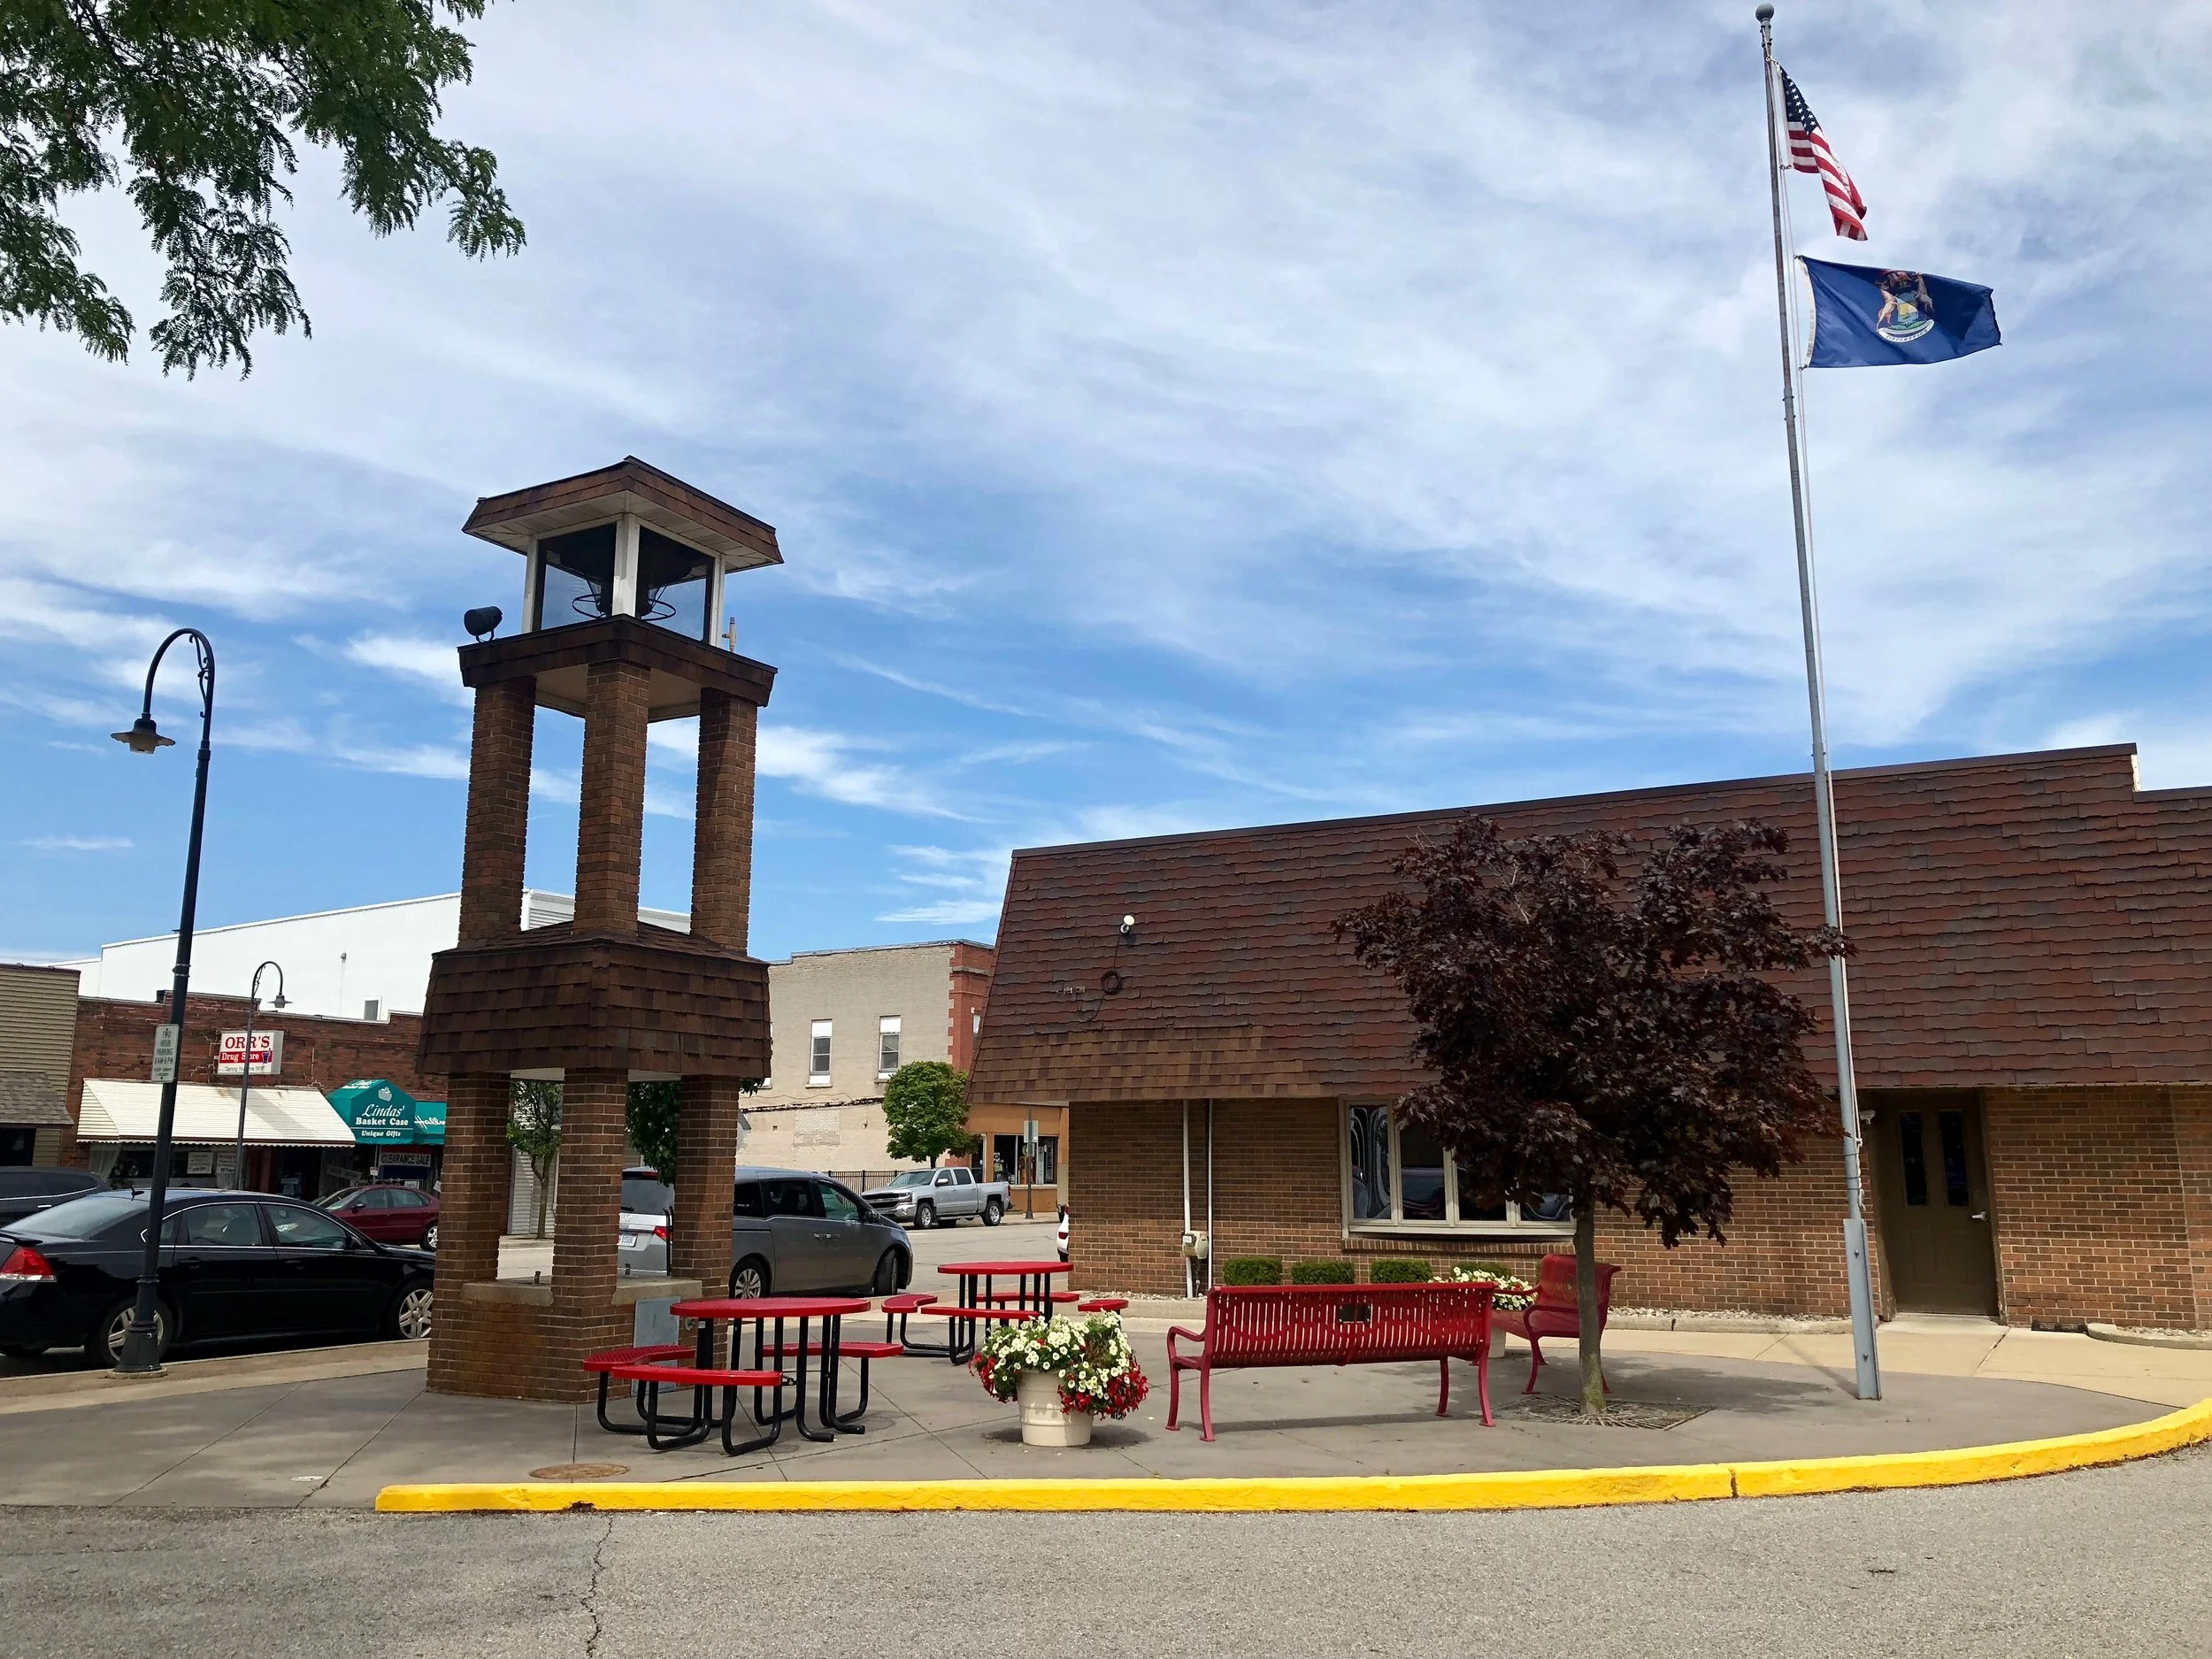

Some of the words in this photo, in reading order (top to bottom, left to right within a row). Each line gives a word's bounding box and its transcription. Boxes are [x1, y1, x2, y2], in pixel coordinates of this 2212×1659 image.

[225, 1035, 270, 1048] ORR'S
[221, 1052, 239, 1063] Drug
[362, 1103, 405, 1118] Lindas'
[356, 1117, 386, 1125] Basket
[381, 1153, 415, 1164] CLEARANCE
[416, 1154, 430, 1164] SALE
